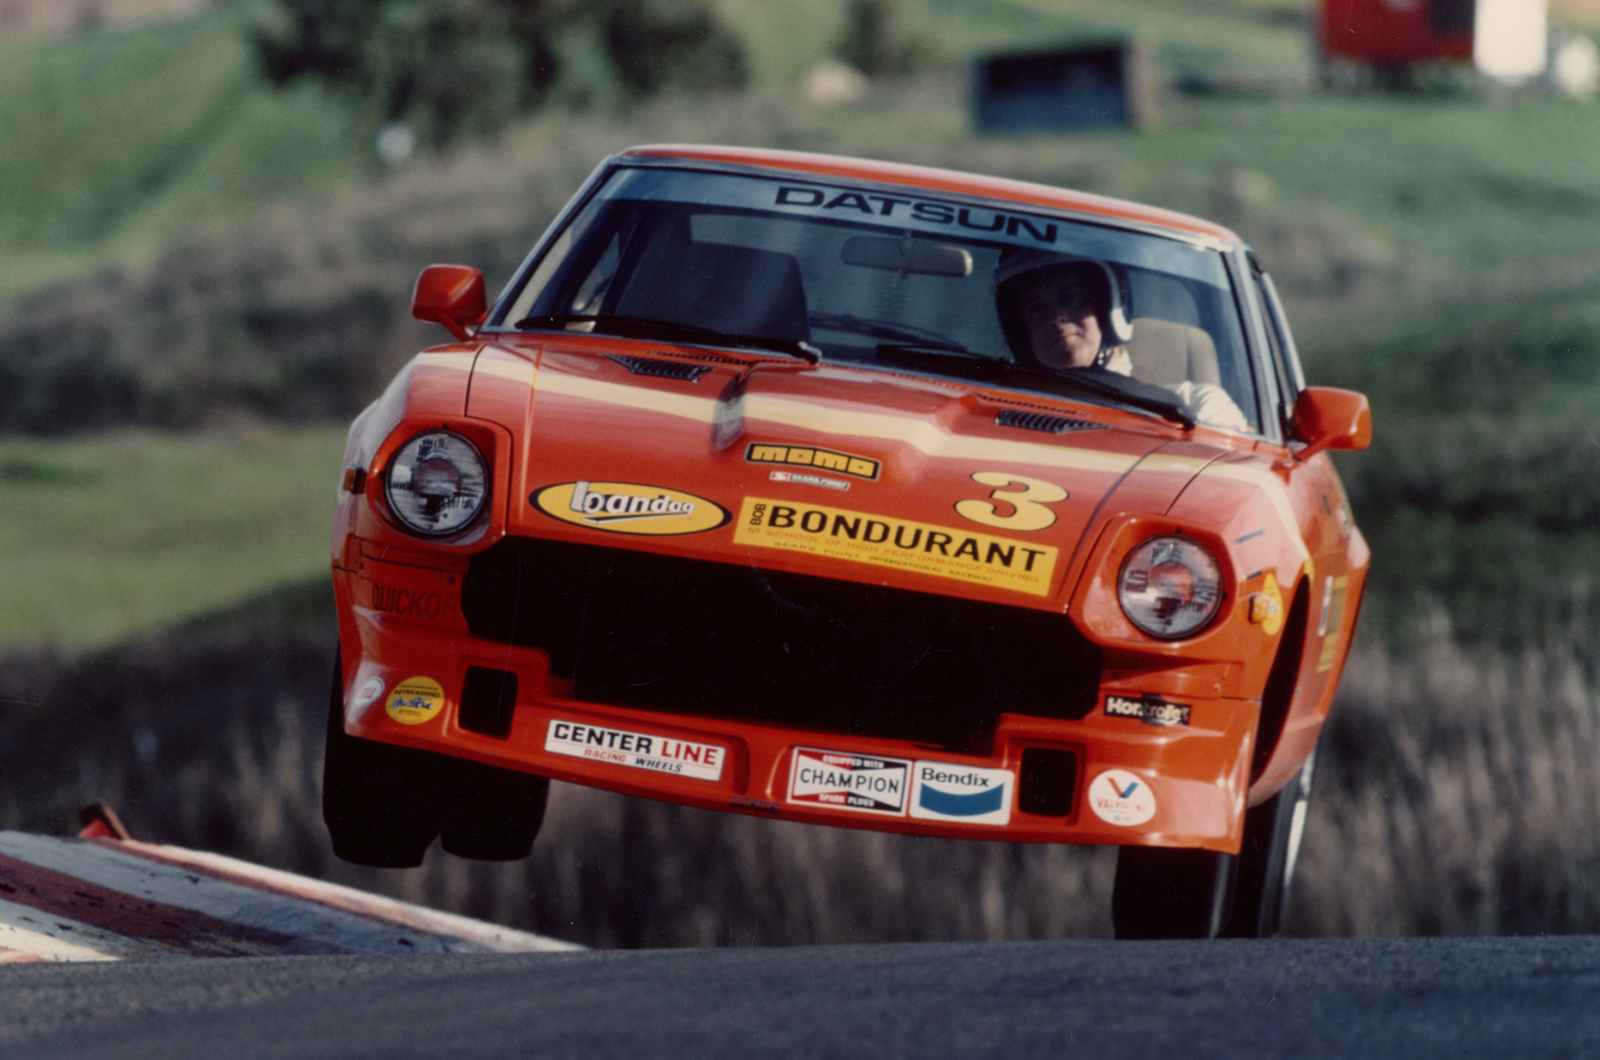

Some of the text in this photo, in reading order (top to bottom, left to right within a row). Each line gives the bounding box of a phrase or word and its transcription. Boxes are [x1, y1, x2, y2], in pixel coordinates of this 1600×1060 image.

[774, 186, 1058, 244] DATSUN
[569, 480, 696, 515] bandag
[750, 503, 767, 526] BOB
[953, 471, 1070, 532] 3
[765, 529, 1040, 583] SCHOOL OF HIGH PERFORMANCE DRIVING
[767, 505, 1046, 572] BONDURANT
[773, 540, 994, 582] SEARS POINT INTERNATIONAL RACEWAY
[553, 723, 719, 766] CENTER LINE
[583, 748, 683, 773] RACING WHEELS
[822, 754, 885, 769] EQUIPPED WITH
[800, 767, 900, 794] CHAMPION
[921, 766, 990, 788] Bendix
[819, 793, 875, 807] SPARK PLUGS
